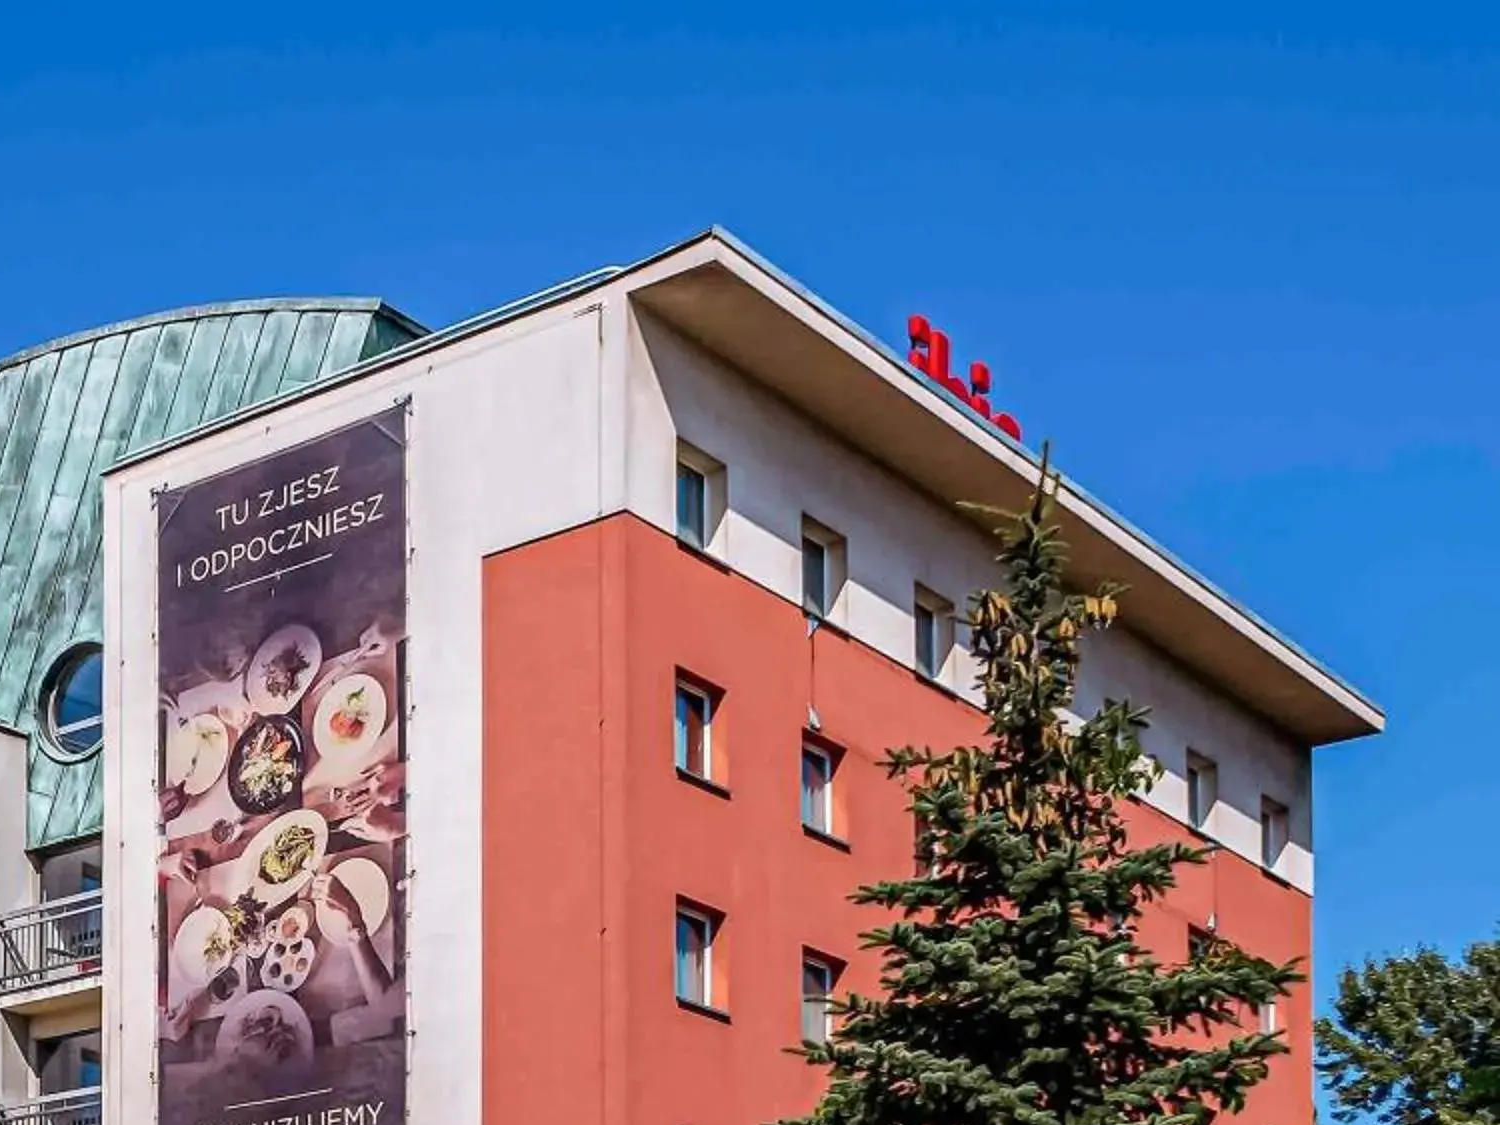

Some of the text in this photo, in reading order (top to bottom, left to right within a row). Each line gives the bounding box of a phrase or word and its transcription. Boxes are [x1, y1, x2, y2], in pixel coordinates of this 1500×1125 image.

[215, 466, 341, 531] TU ZJESZ
[190, 494, 385, 582] ODPOCZNIESZ
